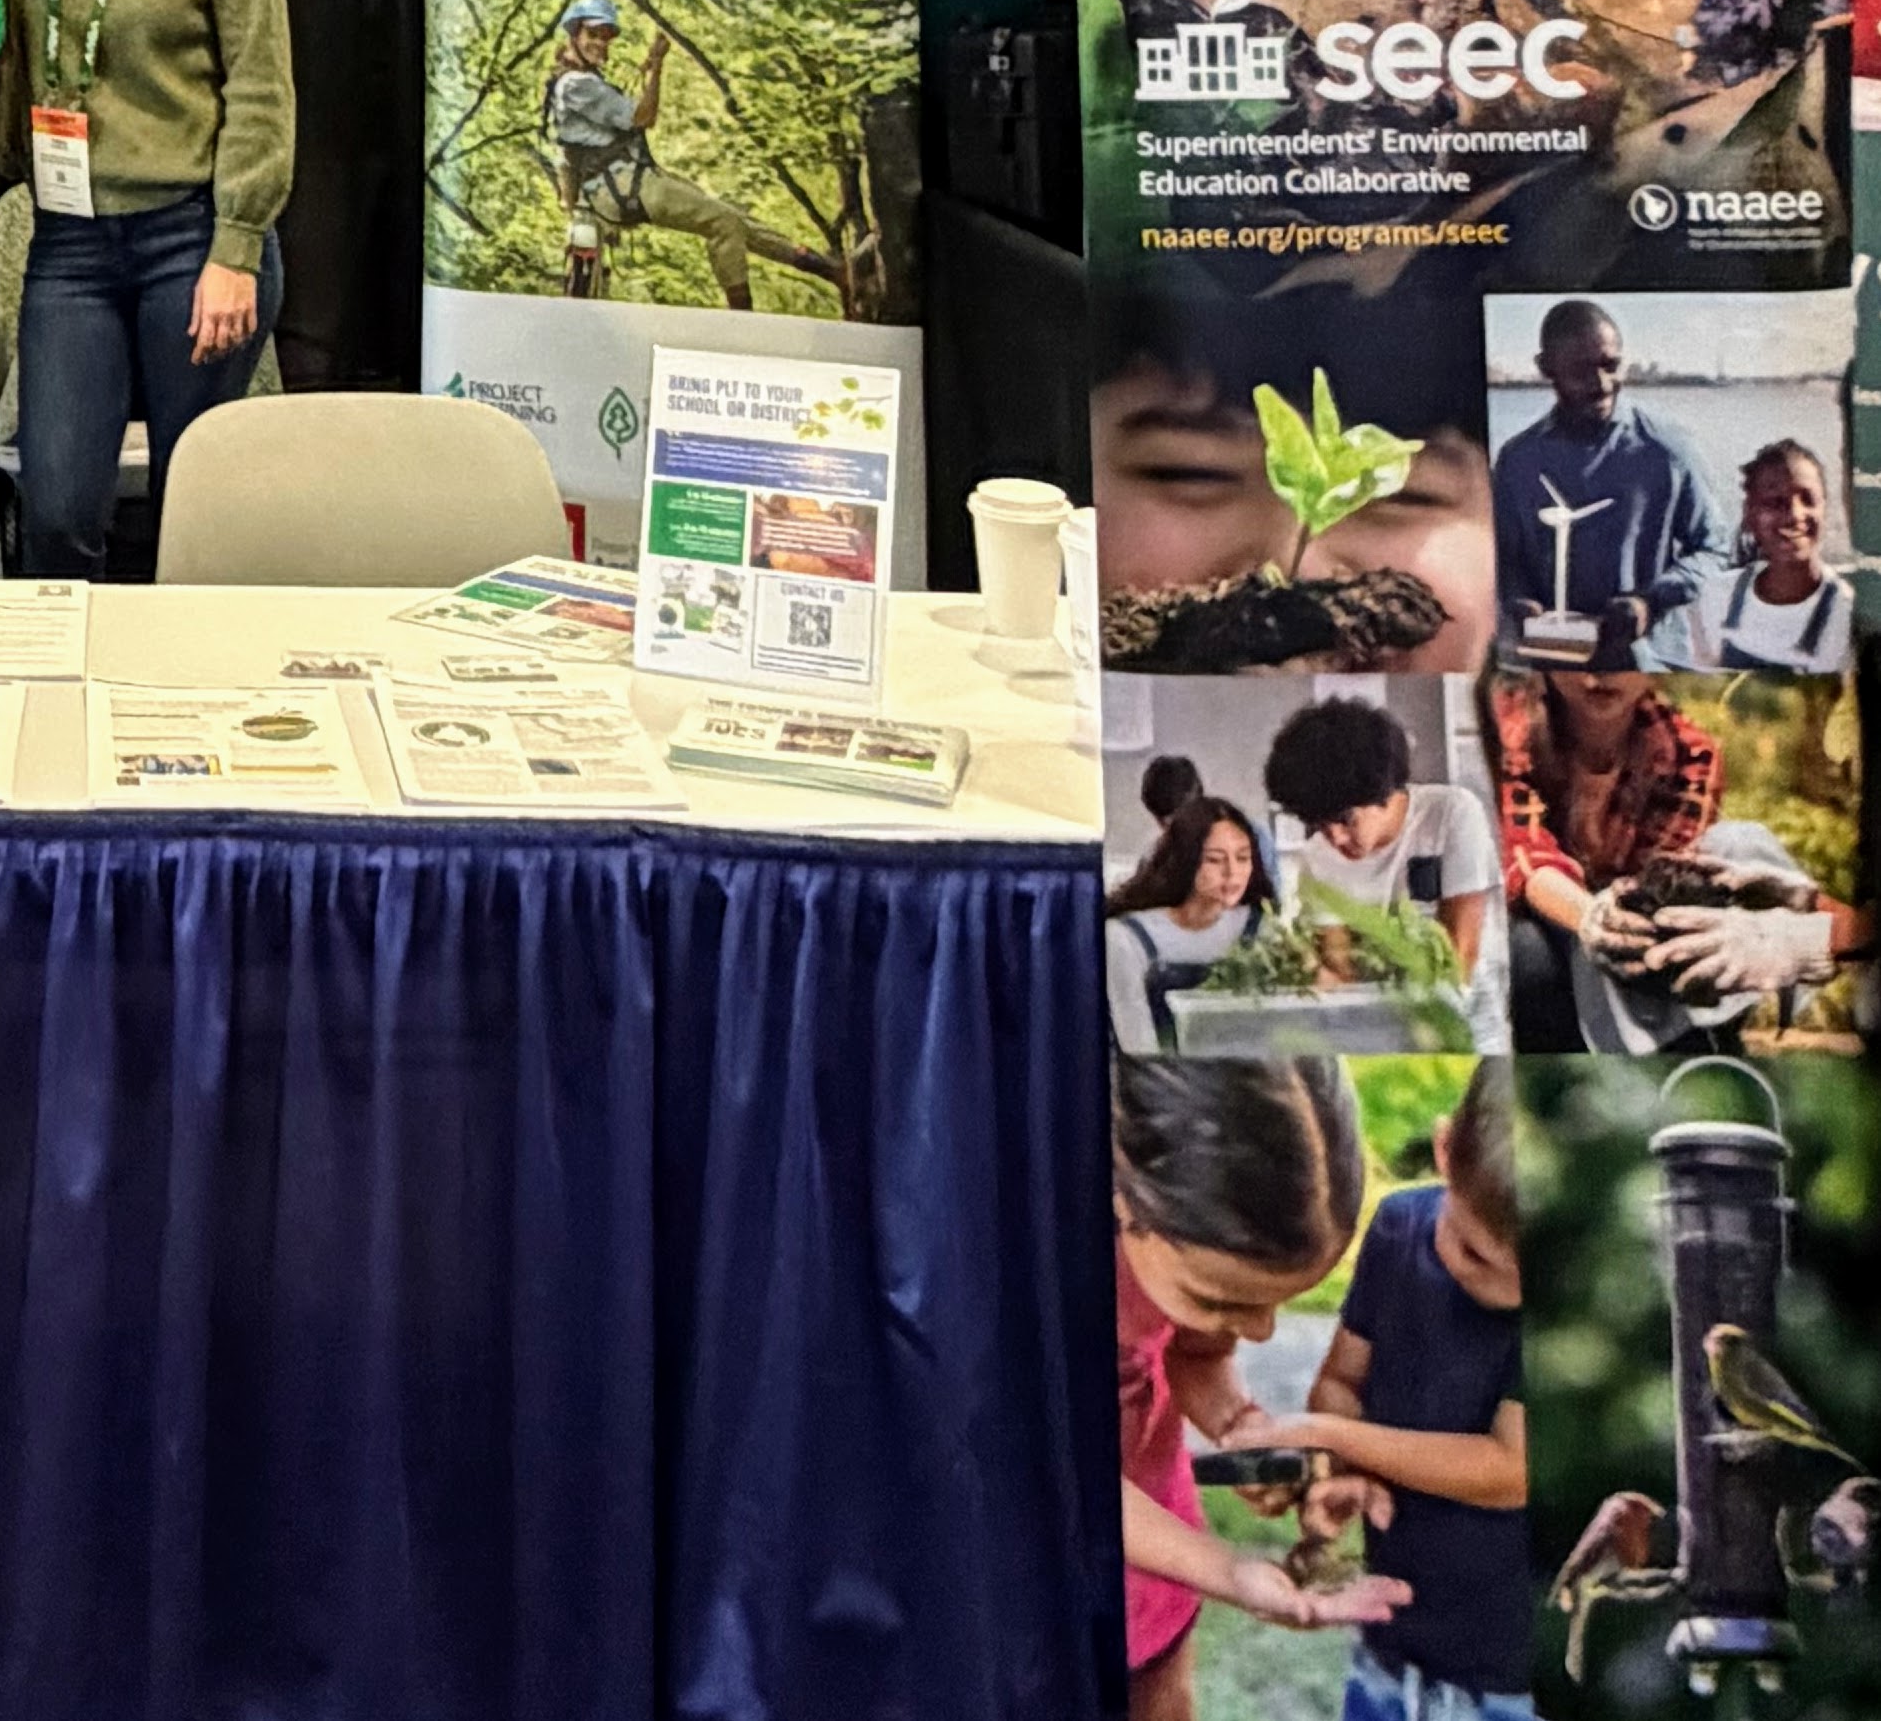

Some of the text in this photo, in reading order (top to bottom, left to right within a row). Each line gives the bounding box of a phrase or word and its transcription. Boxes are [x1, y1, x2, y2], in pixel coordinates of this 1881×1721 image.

[1316, 16, 1588, 104] seec
[1136, 125, 1588, 163] Superintendents' Environmental
[1138, 166, 1472, 198] Education Collaborative
[1685, 189, 1824, 222] naaee
[1141, 219, 1511, 255] naaee.org/programs/seec
